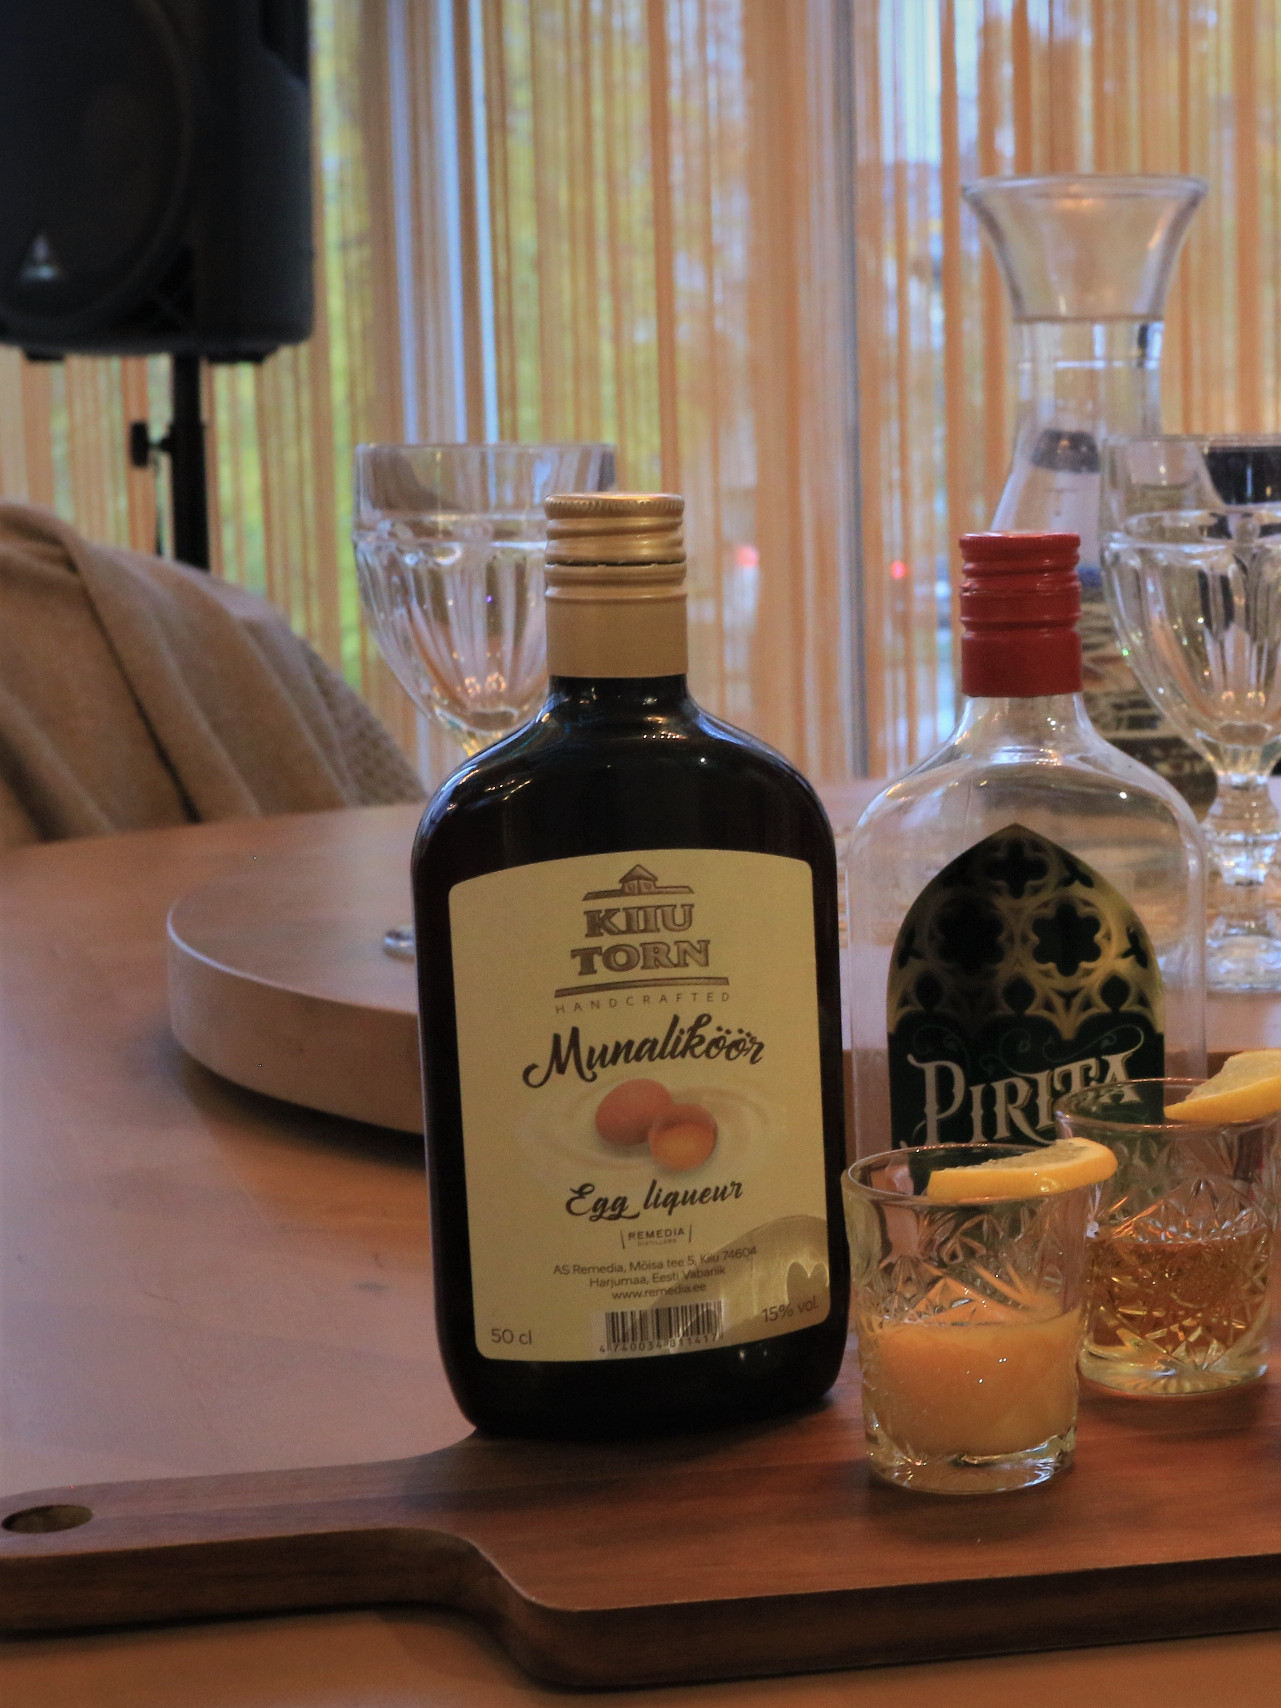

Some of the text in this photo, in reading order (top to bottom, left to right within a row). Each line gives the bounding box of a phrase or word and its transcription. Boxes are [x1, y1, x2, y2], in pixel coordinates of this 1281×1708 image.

[583, 903, 695, 938] KIIU
[570, 939, 711, 977] TORN
[554, 991, 731, 1016] HANDCRAFTED
[522, 1012, 766, 1089] Munaliköör
[907, 1050, 1142, 1146] PIRITA
[565, 1179, 744, 1222] Egg liqueur
[627, 1227, 686, 1241] REMEDIA
[553, 1264, 570, 1275] AS
[573, 1261, 627, 1276] Remedia,
[666, 1257, 685, 1269] tee
[589, 1266, 726, 1290] Harjumaa, Eesti Vabariik
[612, 1282, 708, 1300] www.remedia.ee
[761, 1302, 794, 1323] 15%
[491, 1328, 533, 1345] 50 cl
